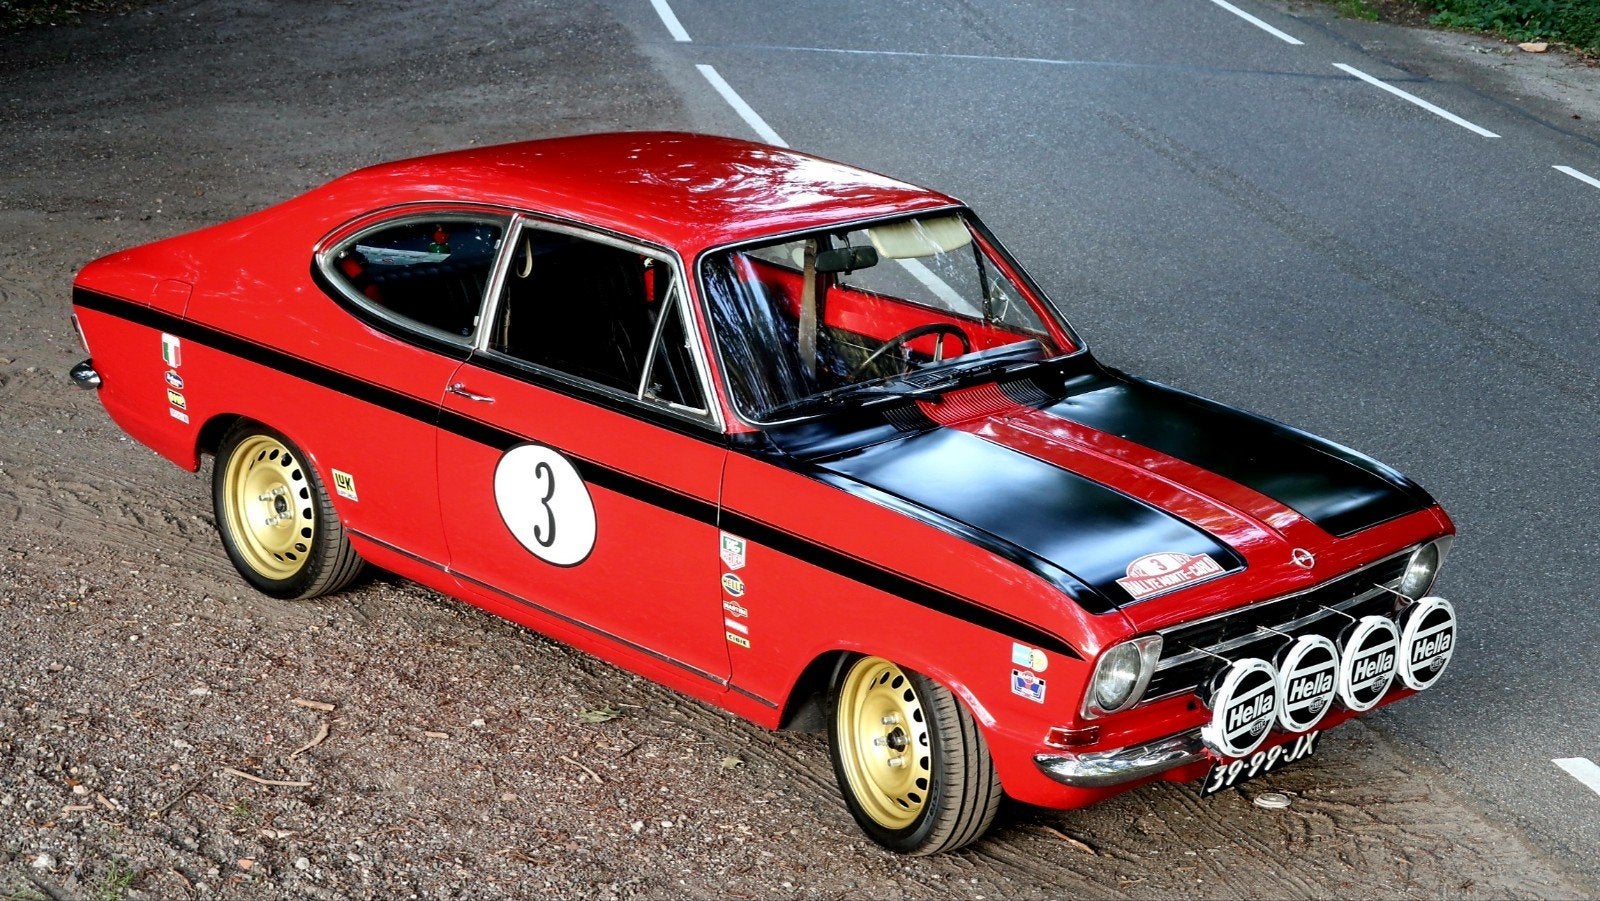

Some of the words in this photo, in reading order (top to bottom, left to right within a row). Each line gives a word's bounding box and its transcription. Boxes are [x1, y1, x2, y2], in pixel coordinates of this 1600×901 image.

[533, 461, 556, 548] 3
[1150, 558, 1168, 571] 3
[1122, 577, 1162, 595] RALLYE
[1412, 634, 1452, 663] Hella
[1353, 653, 1394, 683] Hella
[1289, 672, 1333, 702] Hella
[1228, 692, 1274, 732] Hella
